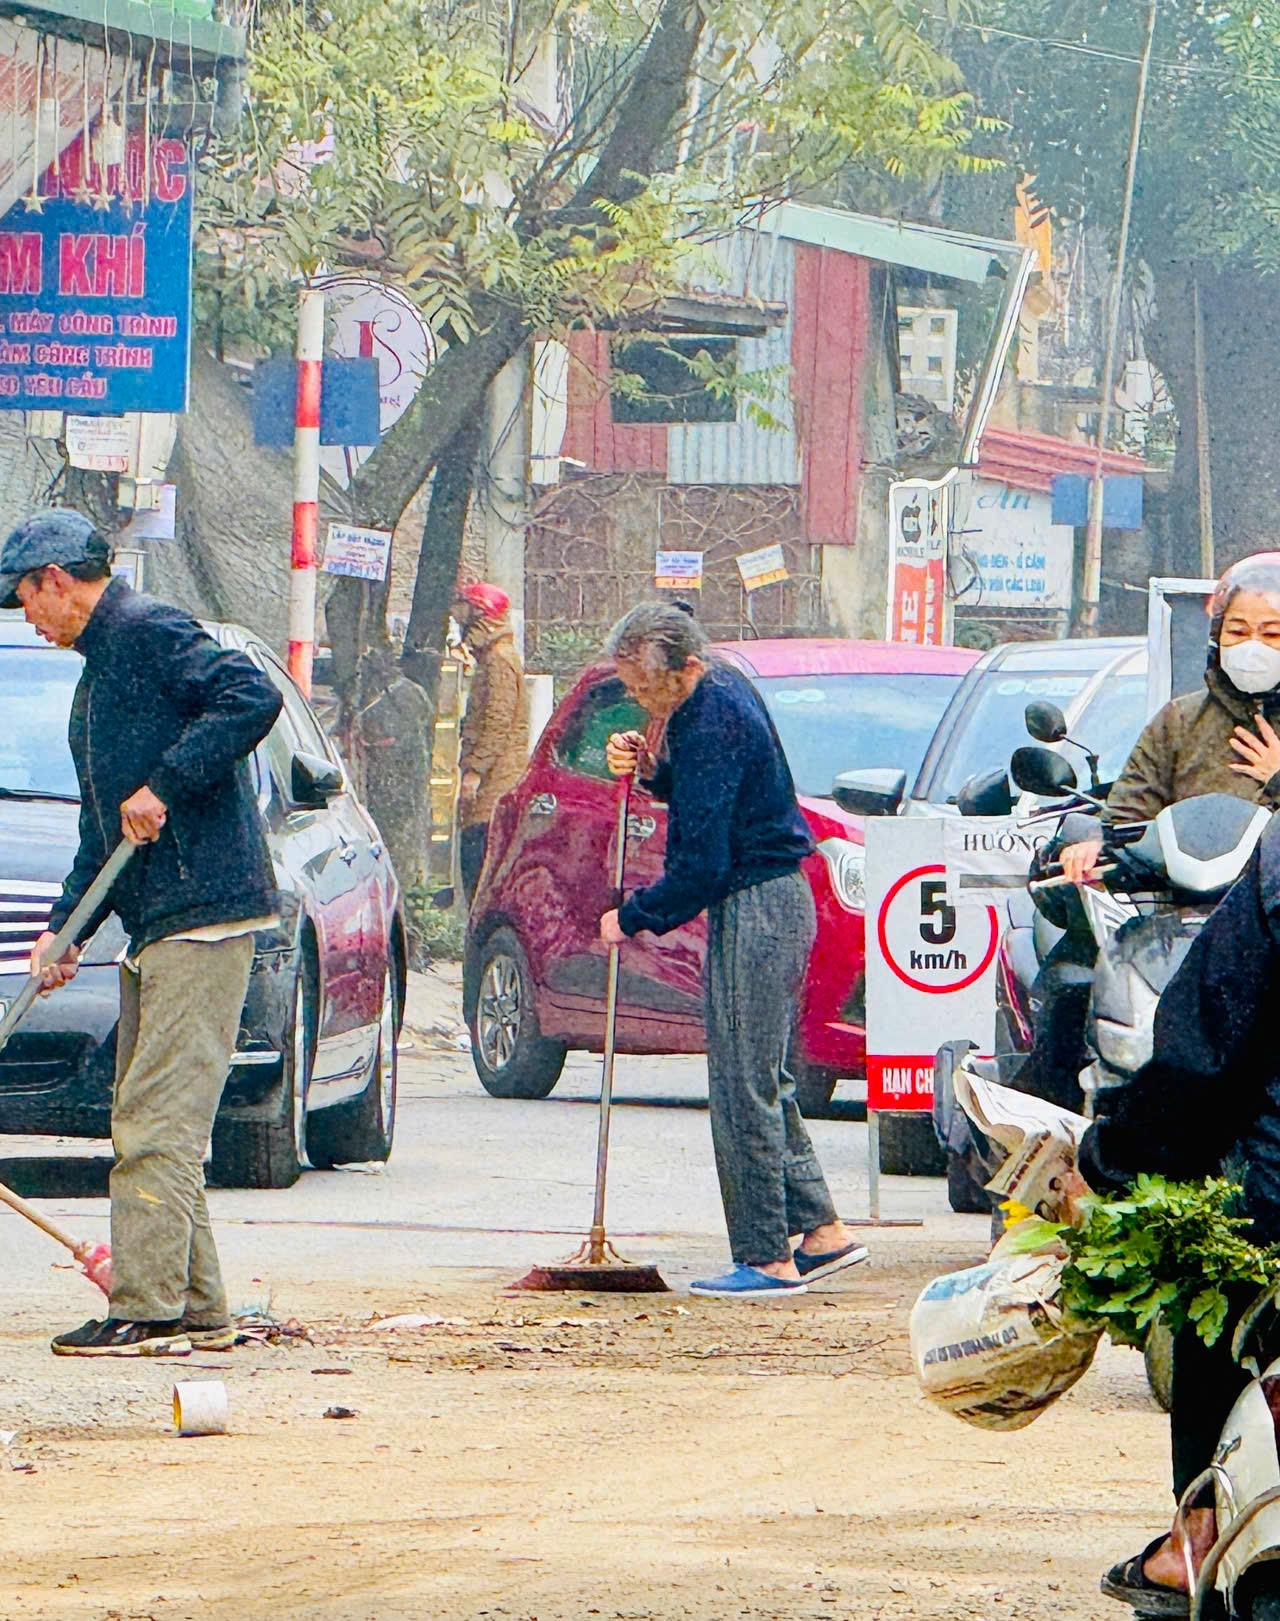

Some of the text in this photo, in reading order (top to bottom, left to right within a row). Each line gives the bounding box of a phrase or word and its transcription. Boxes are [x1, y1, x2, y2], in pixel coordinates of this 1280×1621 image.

[57, 222, 148, 298] KHÍ
[920, 881, 956, 944] 5
[910, 950, 967, 970] km/h
[882, 1067, 912, 1100] HẠN
